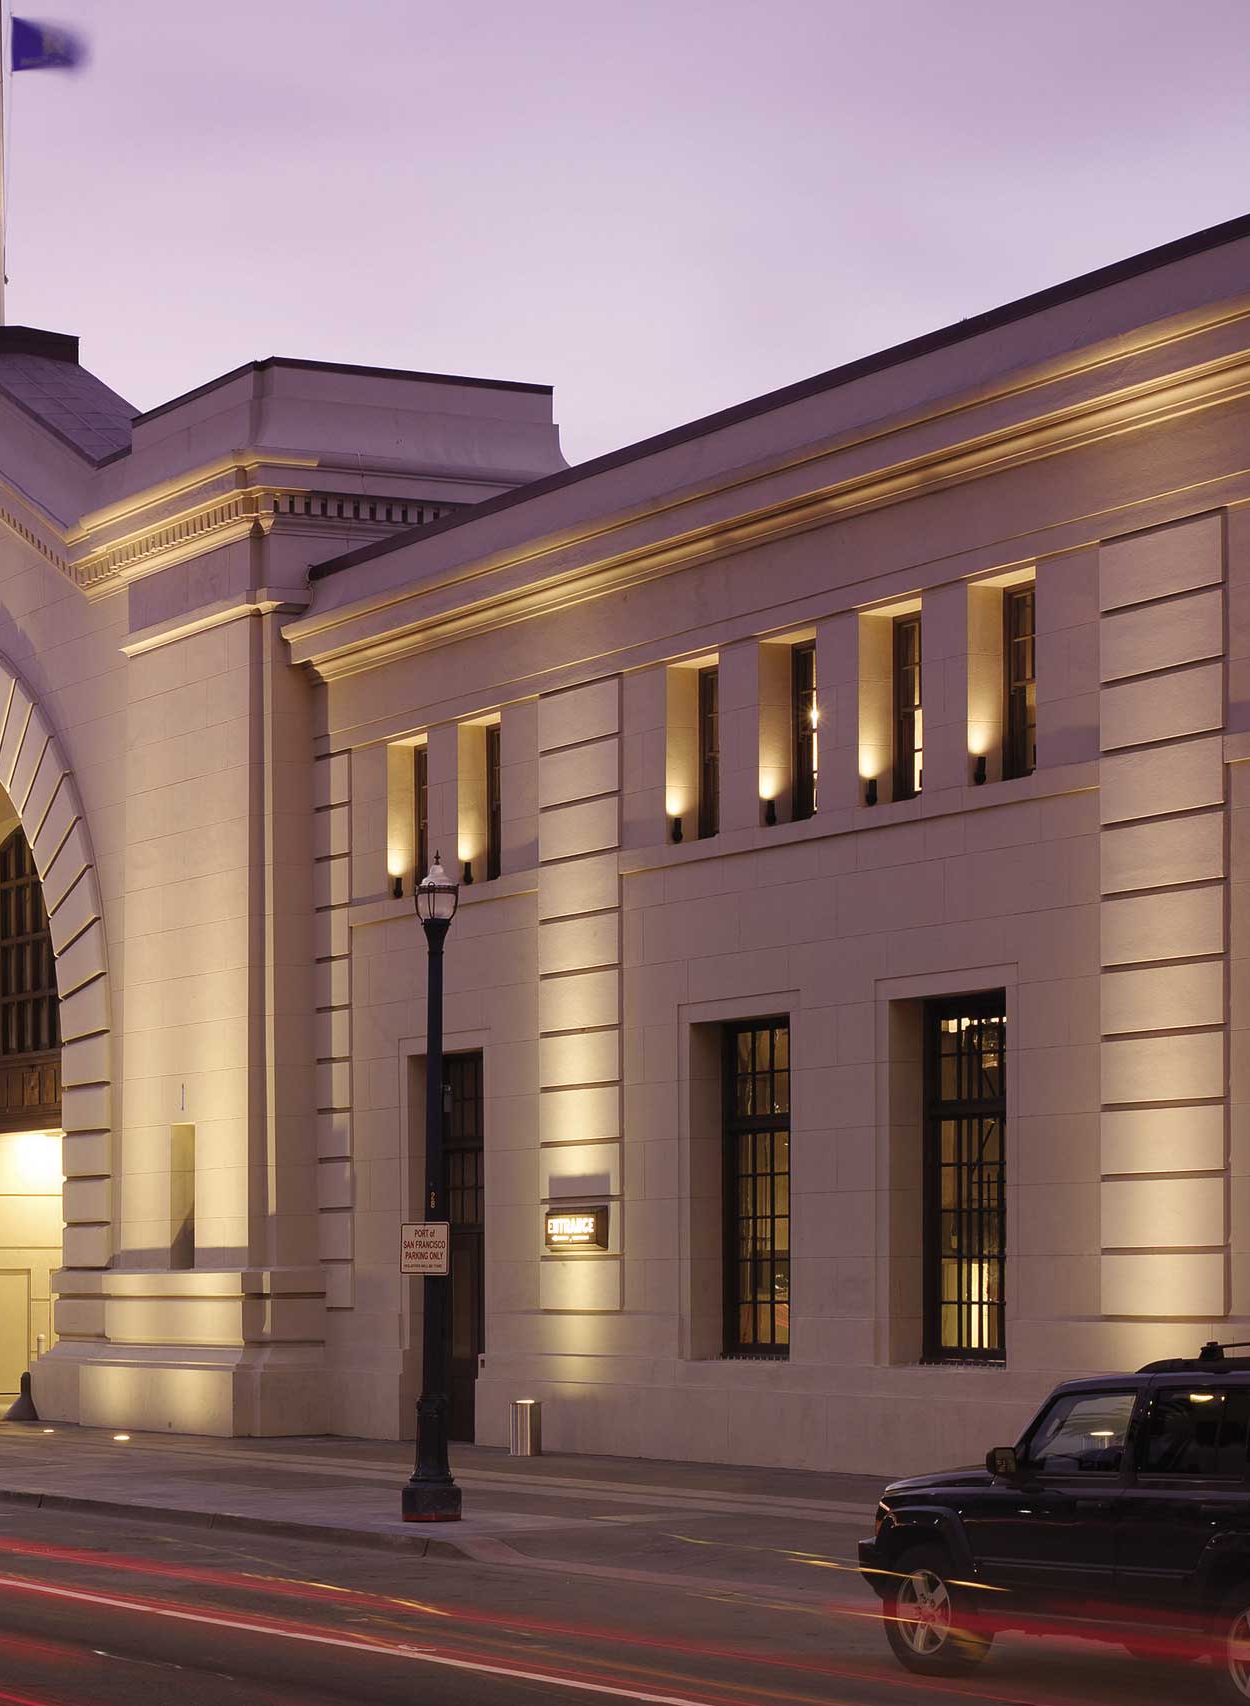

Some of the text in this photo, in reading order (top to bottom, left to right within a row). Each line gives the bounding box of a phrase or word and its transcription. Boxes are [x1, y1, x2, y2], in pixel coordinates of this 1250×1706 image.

[547, 1217, 595, 1234] ENTRANCE
[414, 1230, 435, 1238] PORT of
[403, 1241, 446, 1249] SAN FRANCISCO
[405, 1252, 444, 1260] PARKING ONLY
